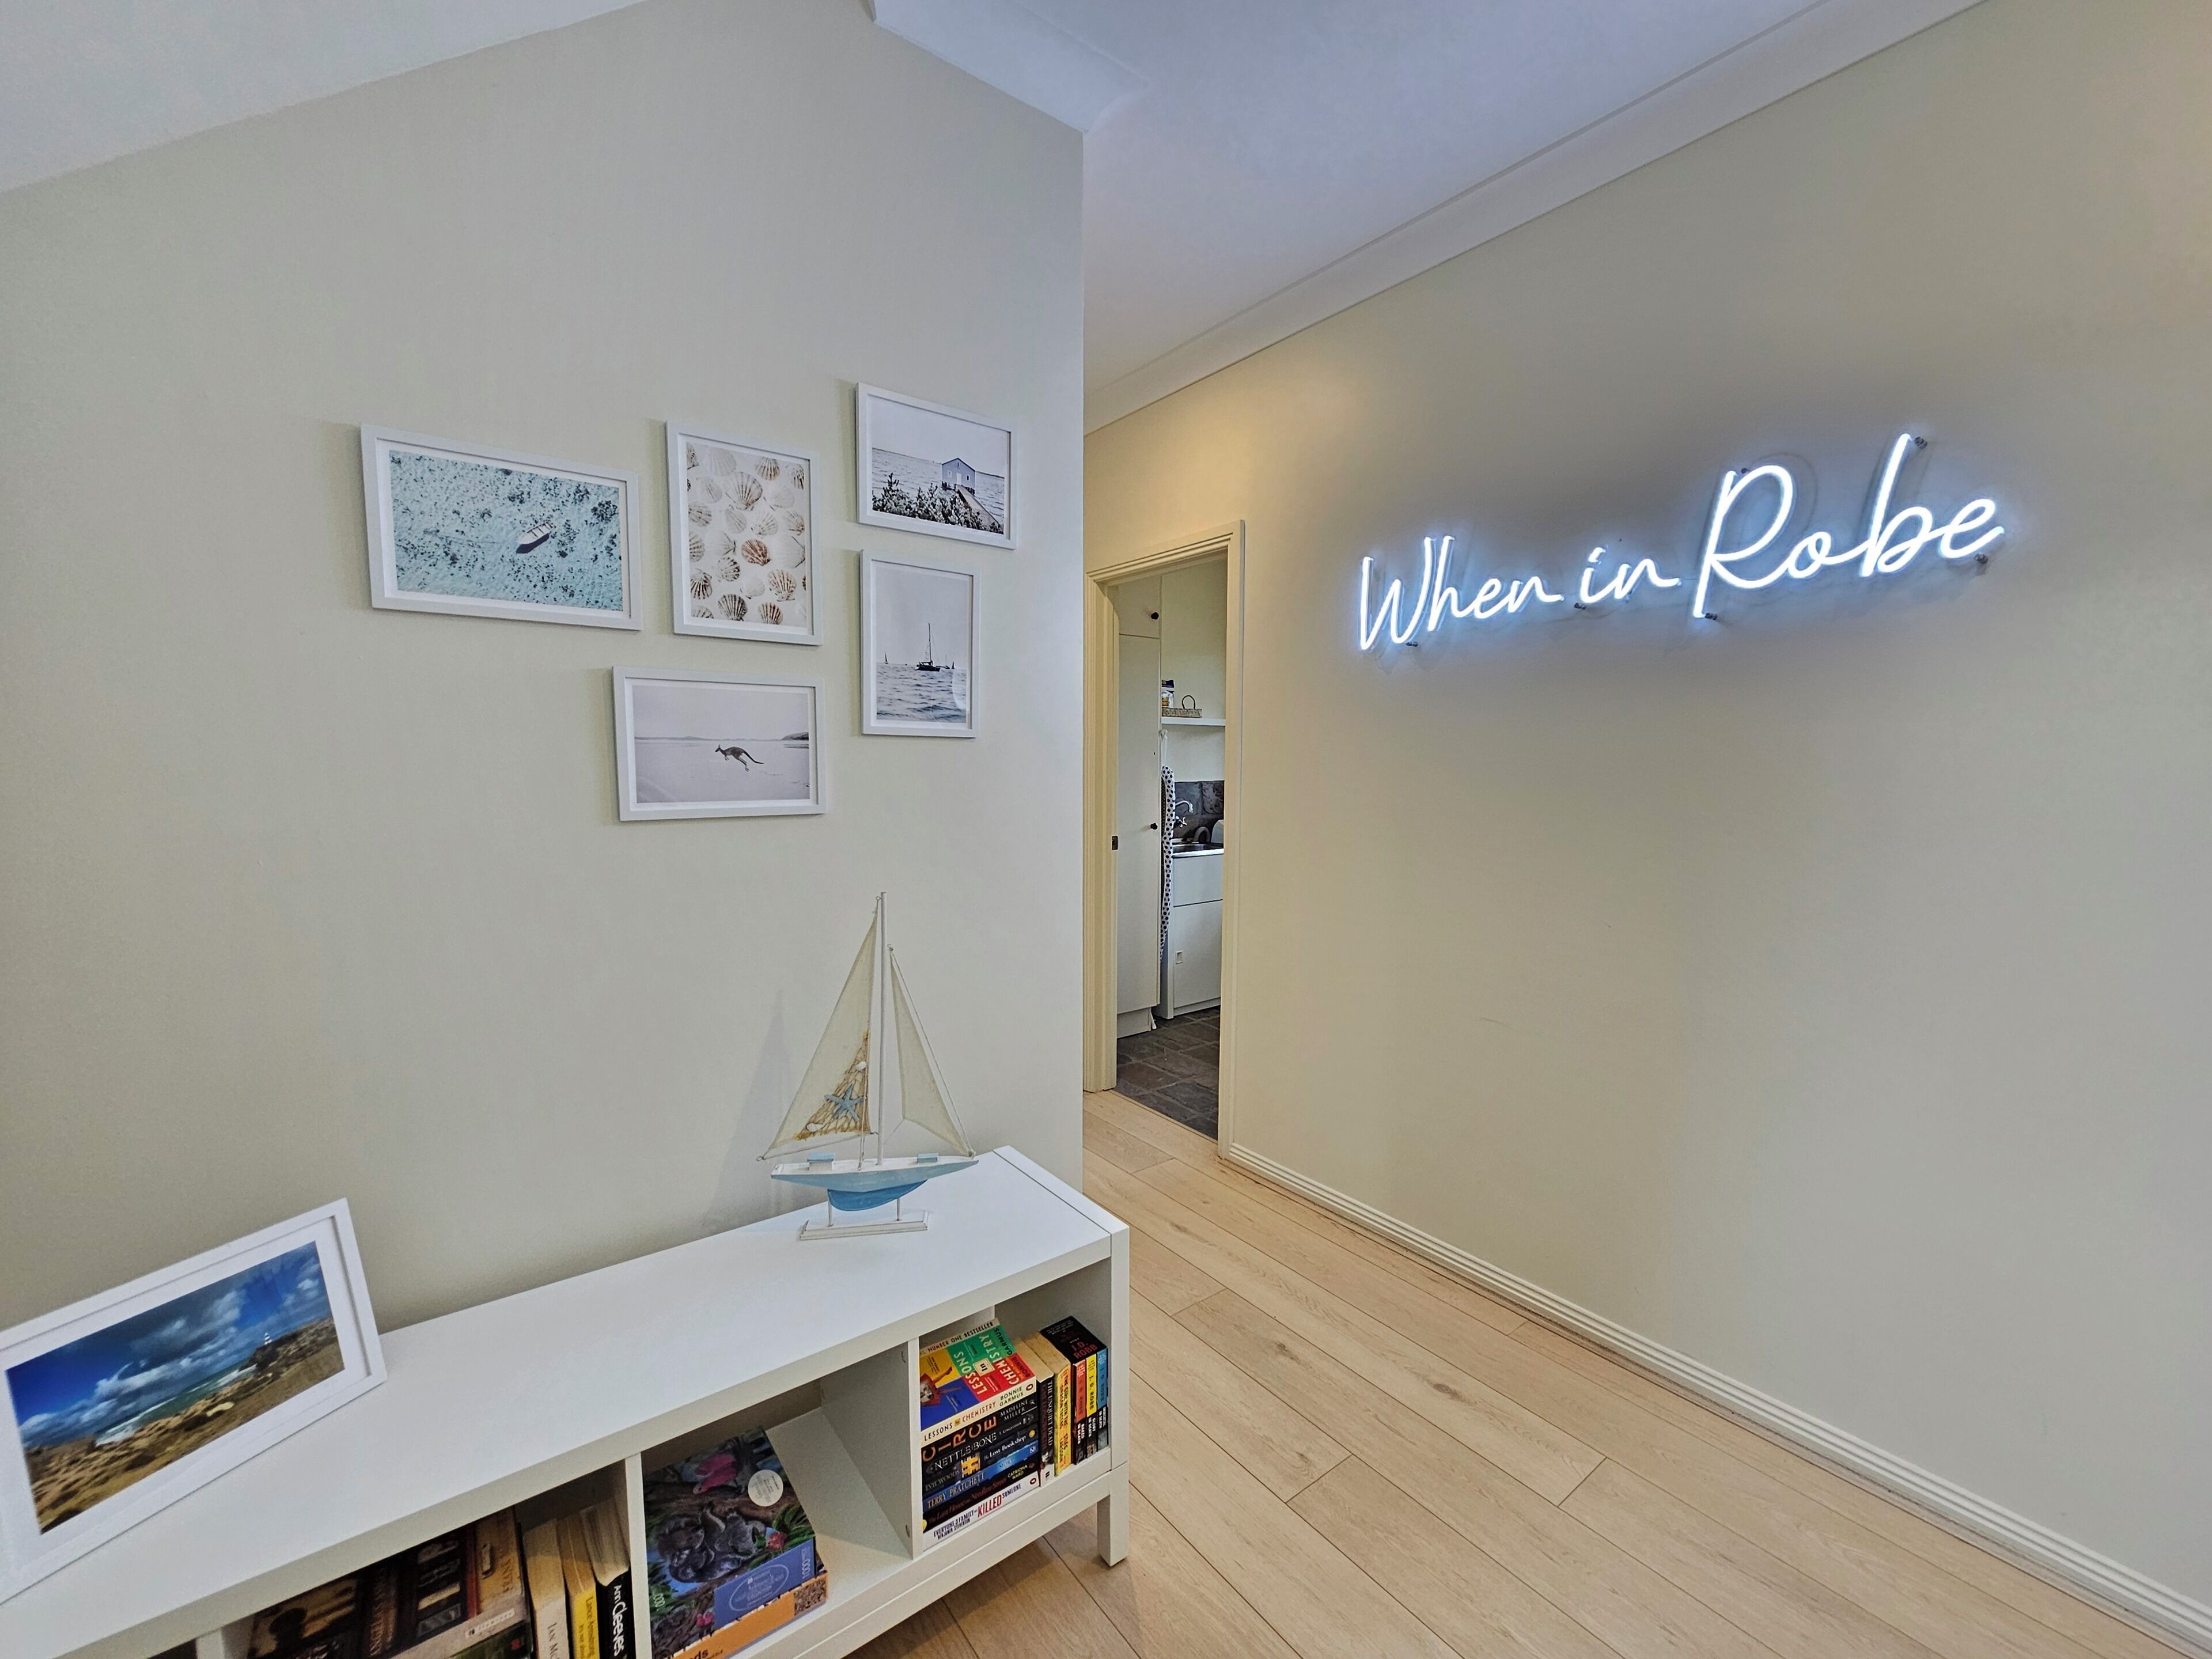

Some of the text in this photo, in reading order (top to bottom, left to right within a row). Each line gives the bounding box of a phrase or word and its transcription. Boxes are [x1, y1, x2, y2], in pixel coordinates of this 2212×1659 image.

[1359, 433, 2004, 652] When in Robe
[928, 1340, 949, 1353] NUMBER
[951, 1335, 963, 1343] ONE
[964, 1321, 994, 1337] BESTSELLER
[994, 1327, 1013, 1355] GARMUS
[1073, 1344, 1097, 1359] ROBB
[953, 1351, 988, 1395] LESSONS
[979, 1334, 1020, 1385] CHEMISTRY
[999, 1392, 1024, 1407] GARMUS
[999, 1399, 1029, 1418] MADELINE
[1000, 1387, 1022, 1401] BONNIE
[924, 1423, 953, 1441] LESSONS
[962, 1402, 996, 1422] CHEMISTRY
[1003, 1407, 1026, 1421] MILLER
[922, 1416, 997, 1462] CIRCE
[1002, 1435, 1027, 1451] Bookshop
[926, 1472, 986, 1509] TERRY PRATCHETT
[1012, 1471, 1024, 1480] WARD
[978, 1494, 1002, 1518] KILLED
[1002, 1483, 1022, 1499] SOMEONE
[801, 1558, 811, 1579] 1000
[612, 1585, 627, 1657] Ann Cleeves
